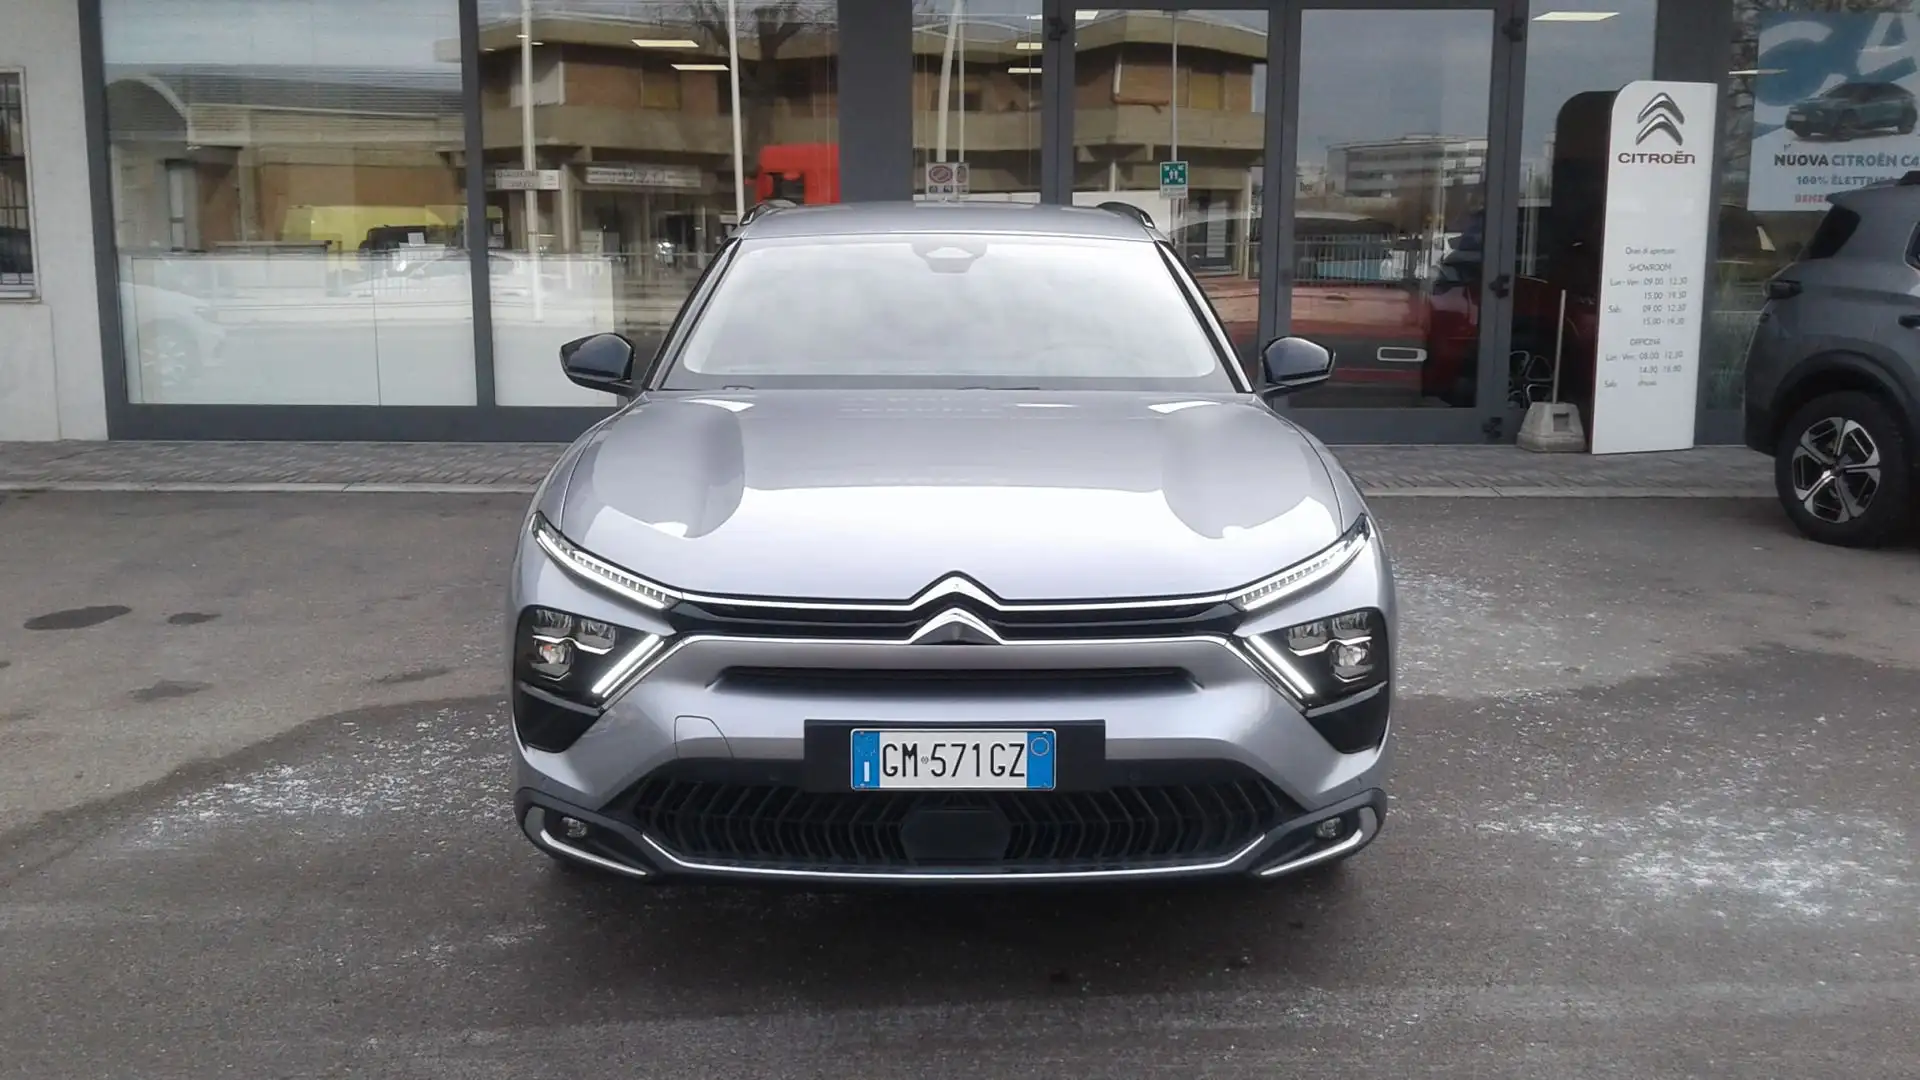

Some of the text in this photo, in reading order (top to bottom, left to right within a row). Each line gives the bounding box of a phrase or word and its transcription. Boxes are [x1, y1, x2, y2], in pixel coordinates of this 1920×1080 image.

[1774, 155, 1828, 166] NUOVA
[1832, 152, 1897, 167] CITROËN
[1796, 175, 1828, 185] 100%
[1628, 263, 1672, 271] SHOWROOM
